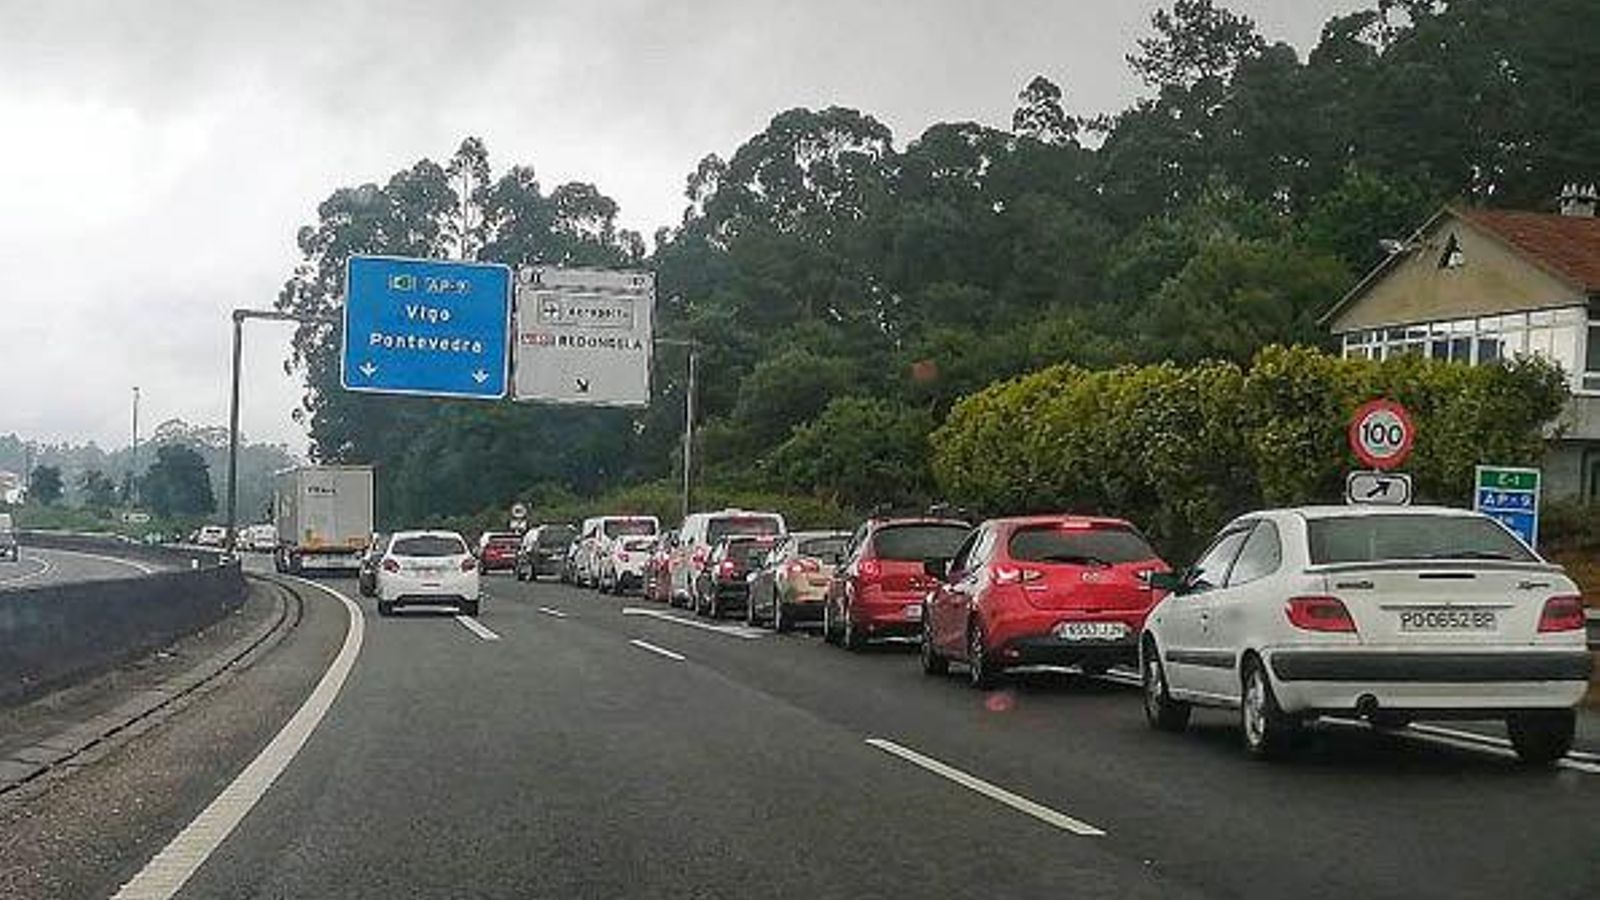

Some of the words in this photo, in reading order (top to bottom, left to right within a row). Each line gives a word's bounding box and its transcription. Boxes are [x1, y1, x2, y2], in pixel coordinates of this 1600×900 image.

[406, 304, 450, 323] Vigo
[370, 333, 482, 353] Pontevedra
[1363, 422, 1403, 446] 100
[1483, 493, 1531, 507] AP-9
